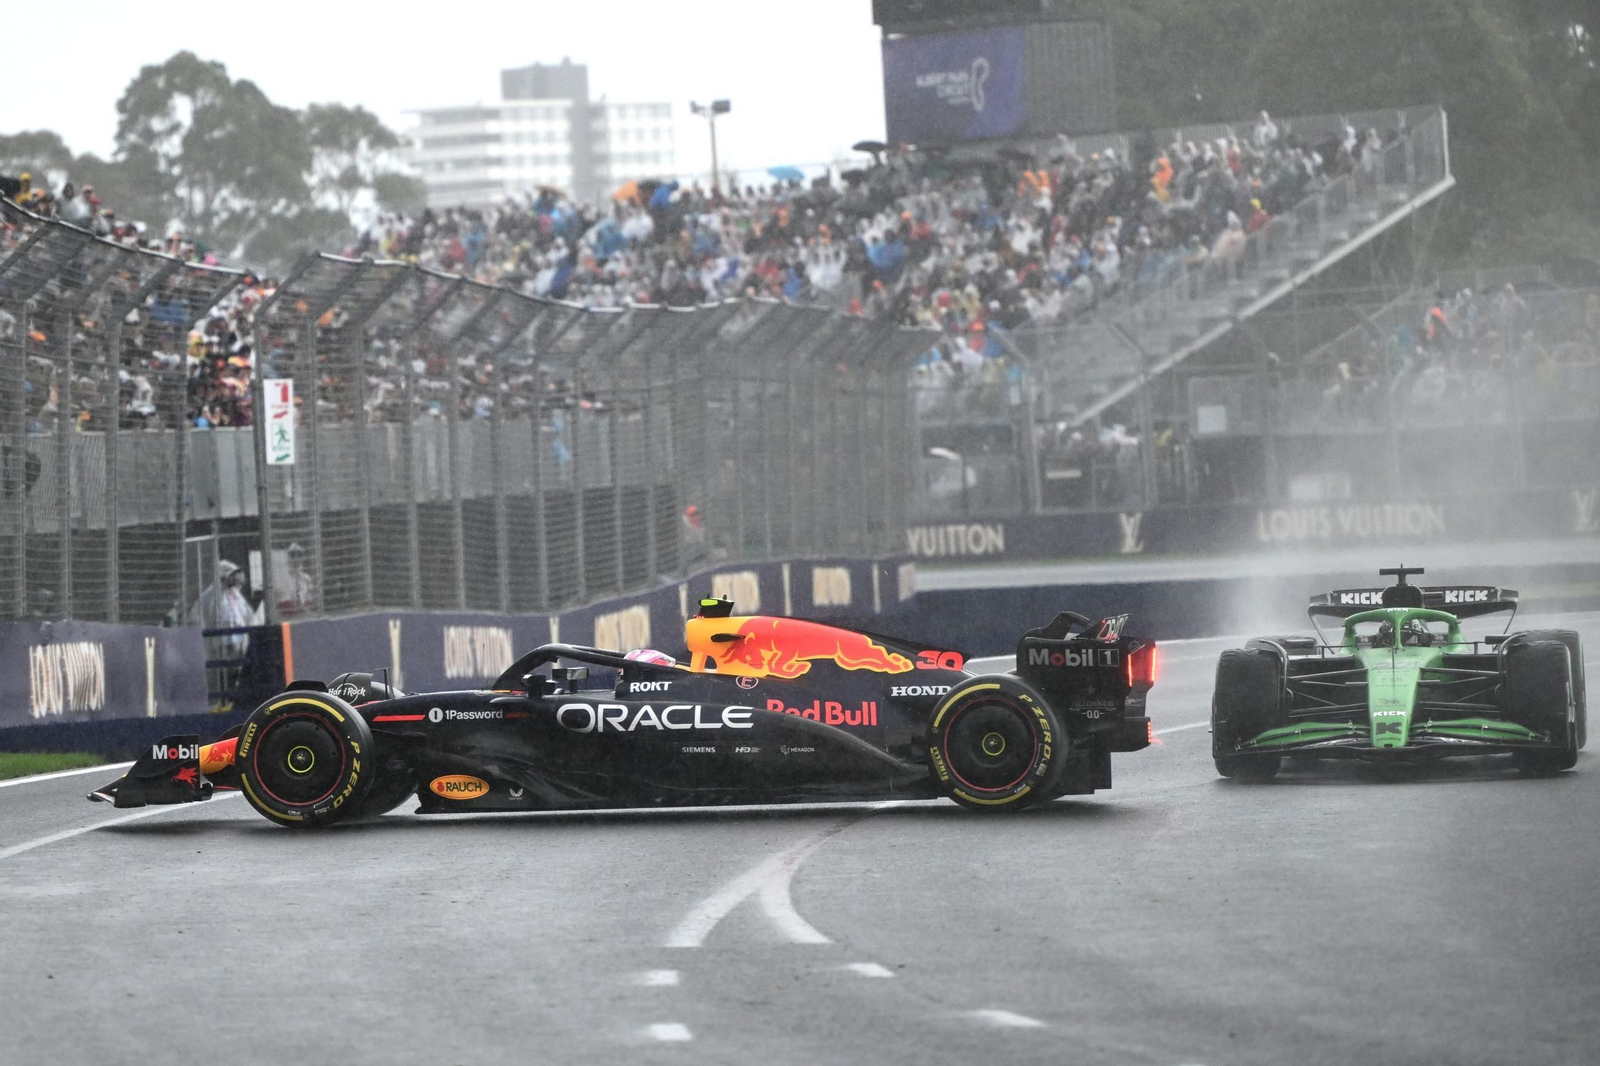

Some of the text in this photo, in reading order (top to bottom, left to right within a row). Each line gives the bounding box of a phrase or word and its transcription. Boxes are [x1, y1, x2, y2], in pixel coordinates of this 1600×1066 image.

[1257, 503, 1445, 542] LOUIS VUITTON
[906, 523, 1005, 556] VUITTON
[1341, 592, 1383, 605] KICK
[1445, 590, 1488, 603] KICK
[916, 650, 964, 671] 30
[1028, 648, 1093, 667] Mobil
[347, 686, 366, 697] Rock
[630, 682, 672, 693] ROKT
[891, 685, 952, 697] HOND
[445, 709, 503, 720] 1Password
[556, 703, 755, 733] ORACLE
[825, 701, 878, 726] Bull
[1018, 694, 1033, 702] P
[1031, 706, 1052, 760] ZERO
[152, 744, 199, 760] Mobil
[333, 741, 361, 809] P ZERO
[446, 781, 482, 792] RAUCH
